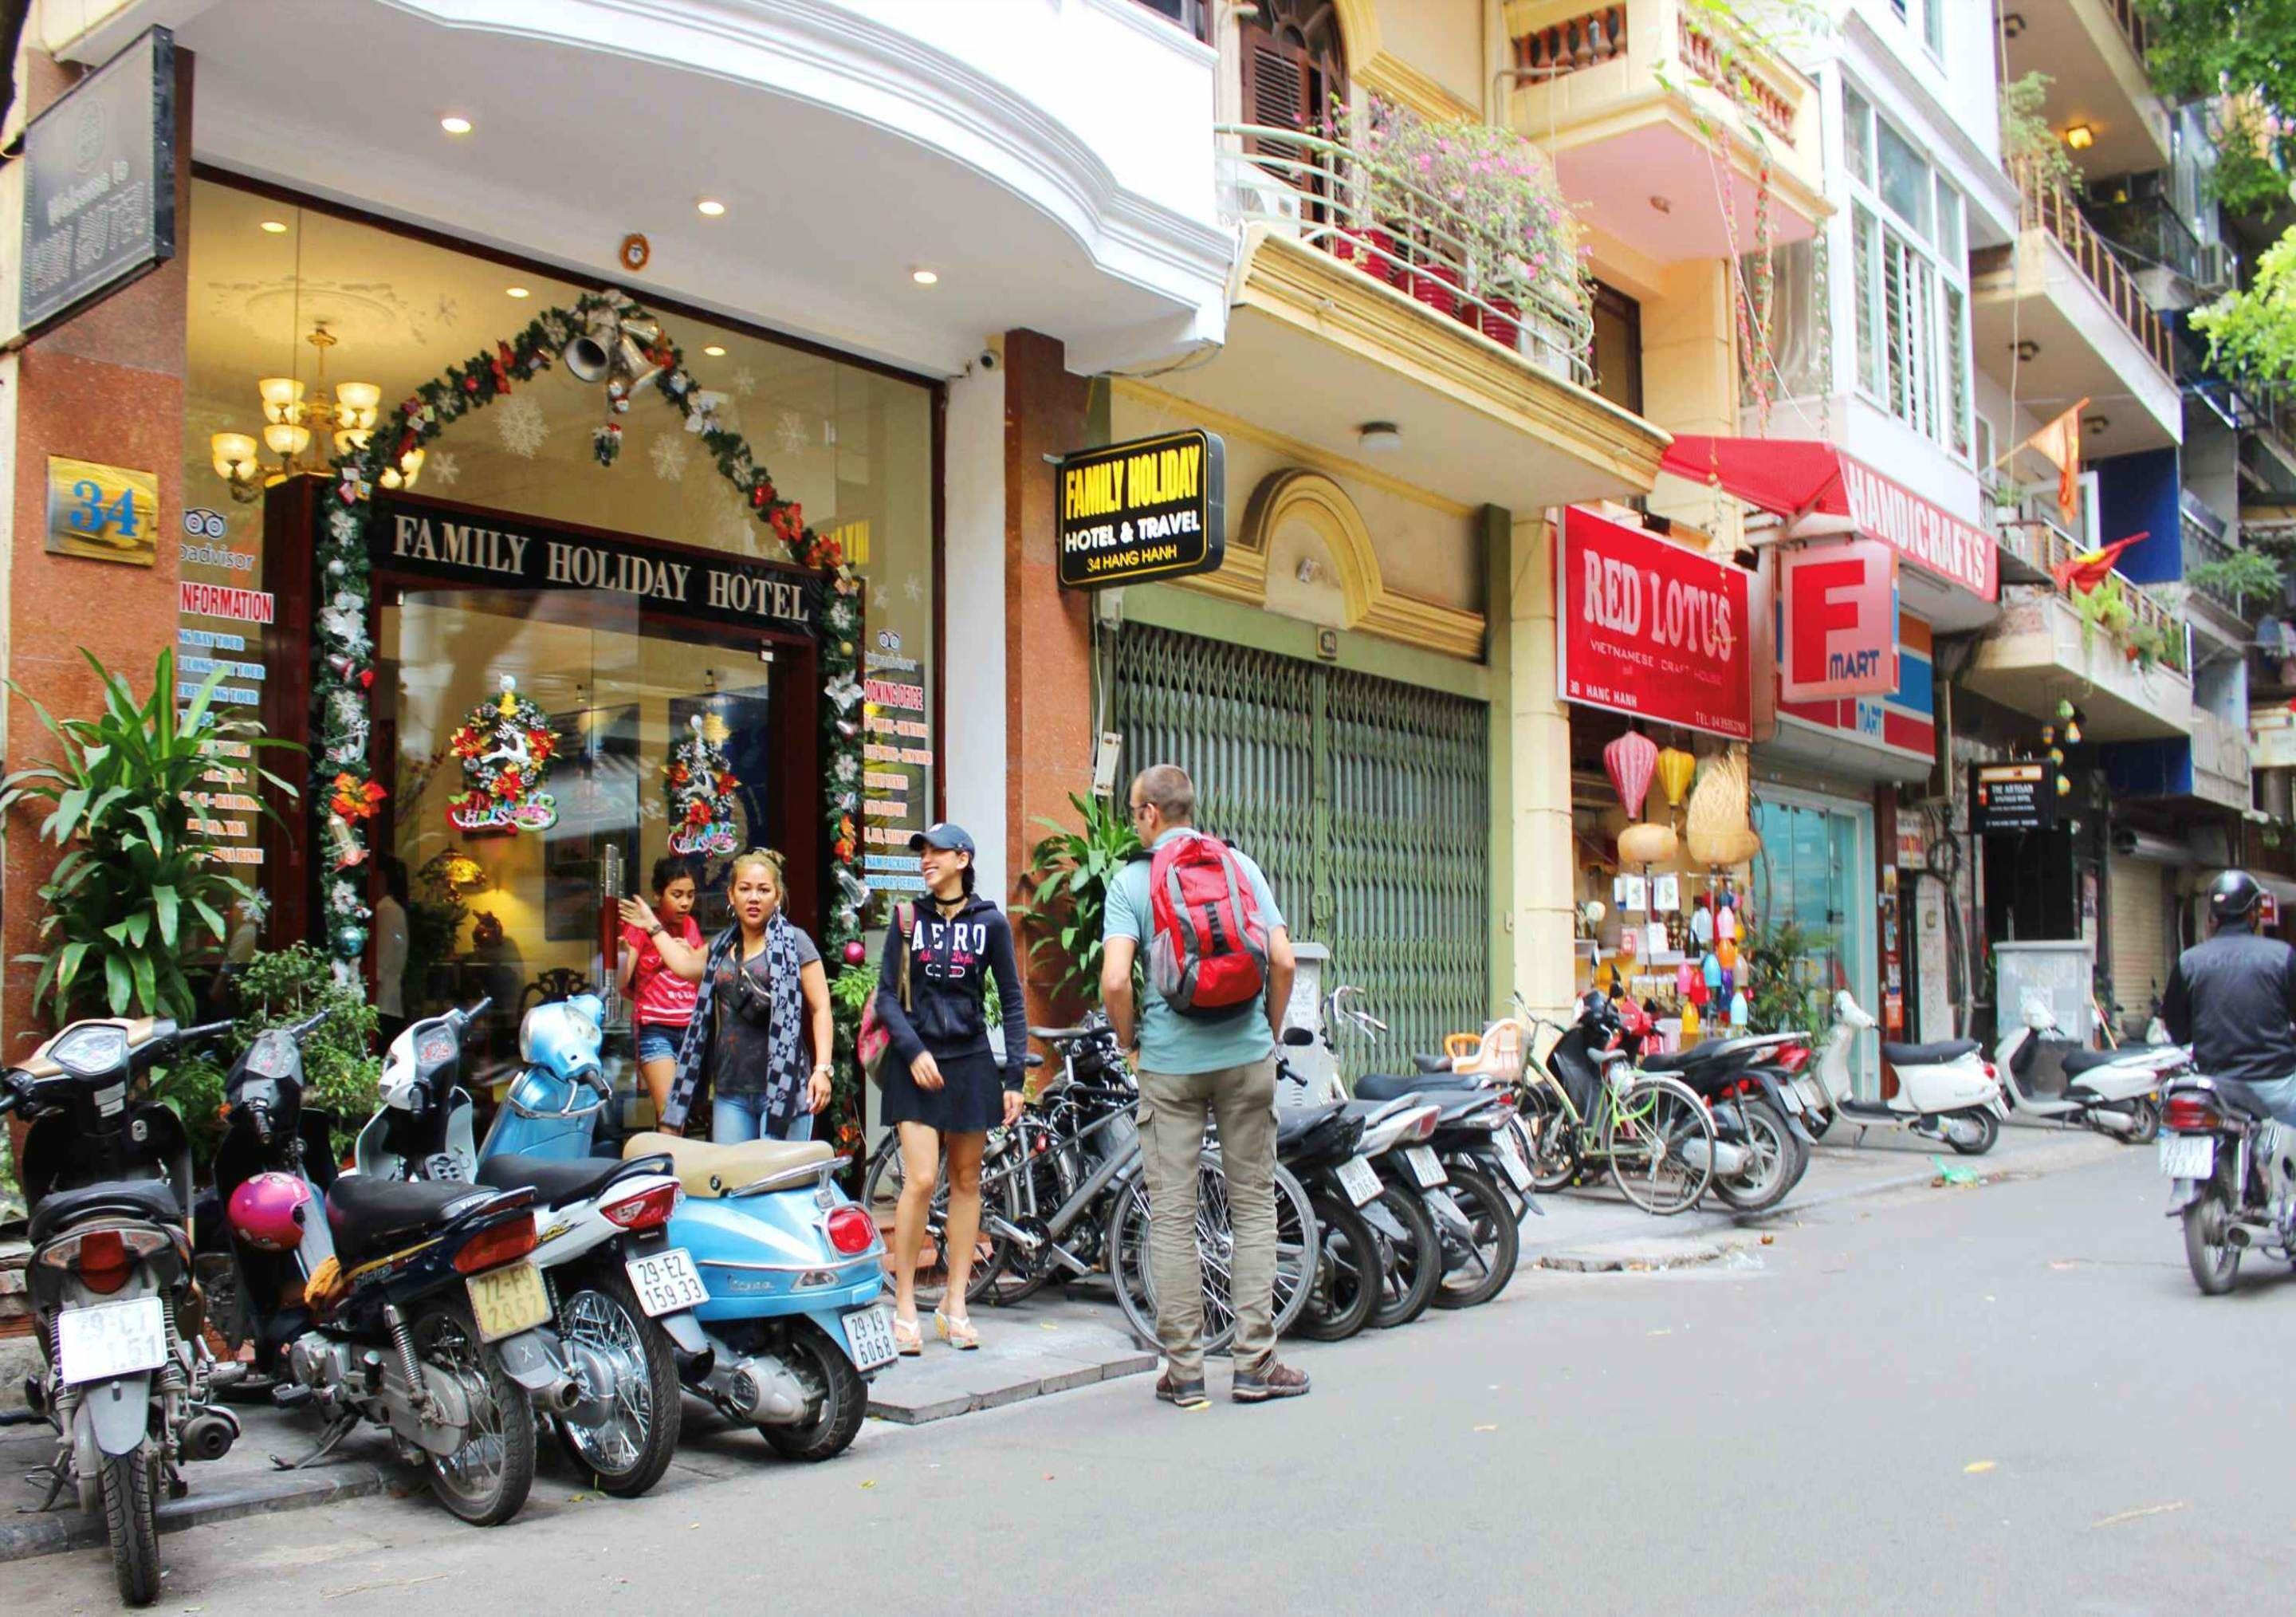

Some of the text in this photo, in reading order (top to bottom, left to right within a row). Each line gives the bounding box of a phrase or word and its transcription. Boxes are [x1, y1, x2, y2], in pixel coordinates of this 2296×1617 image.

[1066, 445, 1200, 520] FAMILY HOLIDAY
[69, 480, 138, 537] 34
[1848, 462, 1986, 588] HANDICRAFTS
[1065, 510, 1201, 553] HOTEL & TRAVEL
[393, 514, 809, 622] FAMILY HOLIDAY HOTEL
[1087, 545, 1177, 572] 34 HANG HANH
[1582, 548, 1732, 663] RED LOTUS
[1792, 560, 1865, 684] F
[1590, 638, 1654, 668] VIETNAMESE
[1829, 650, 1879, 679] MART
[911, 920, 986, 955] AERO
[638, 1256, 686, 1285] 29-E2
[645, 1278, 702, 1310] 159.33
[859, 1336, 892, 1364] 6068
